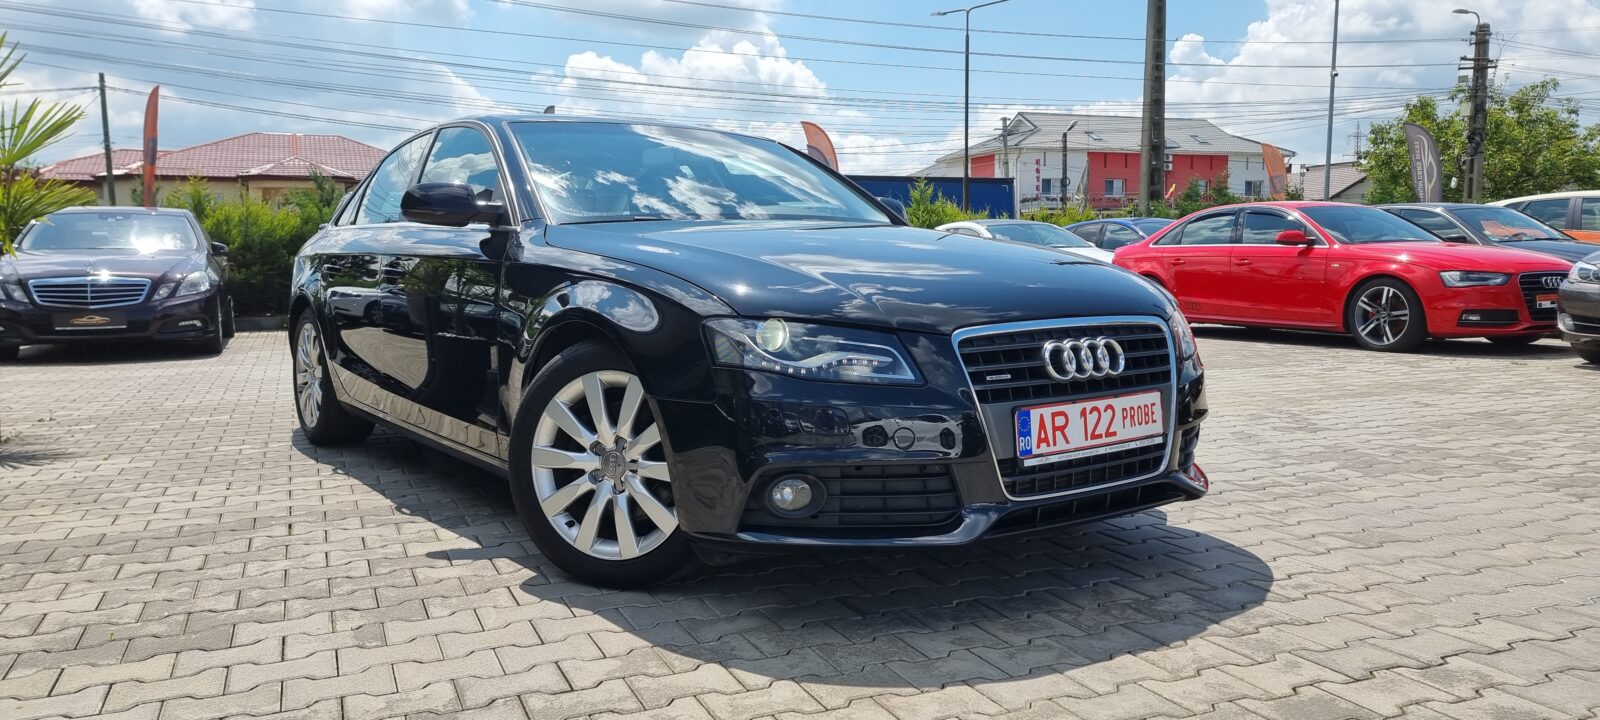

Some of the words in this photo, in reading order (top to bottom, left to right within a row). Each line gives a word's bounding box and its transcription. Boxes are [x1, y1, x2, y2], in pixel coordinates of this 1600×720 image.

[1036, 411, 1071, 449] AR
[1080, 404, 1118, 441] 122
[1122, 402, 1157, 429] PROBE
[1019, 436, 1031, 451] RO
